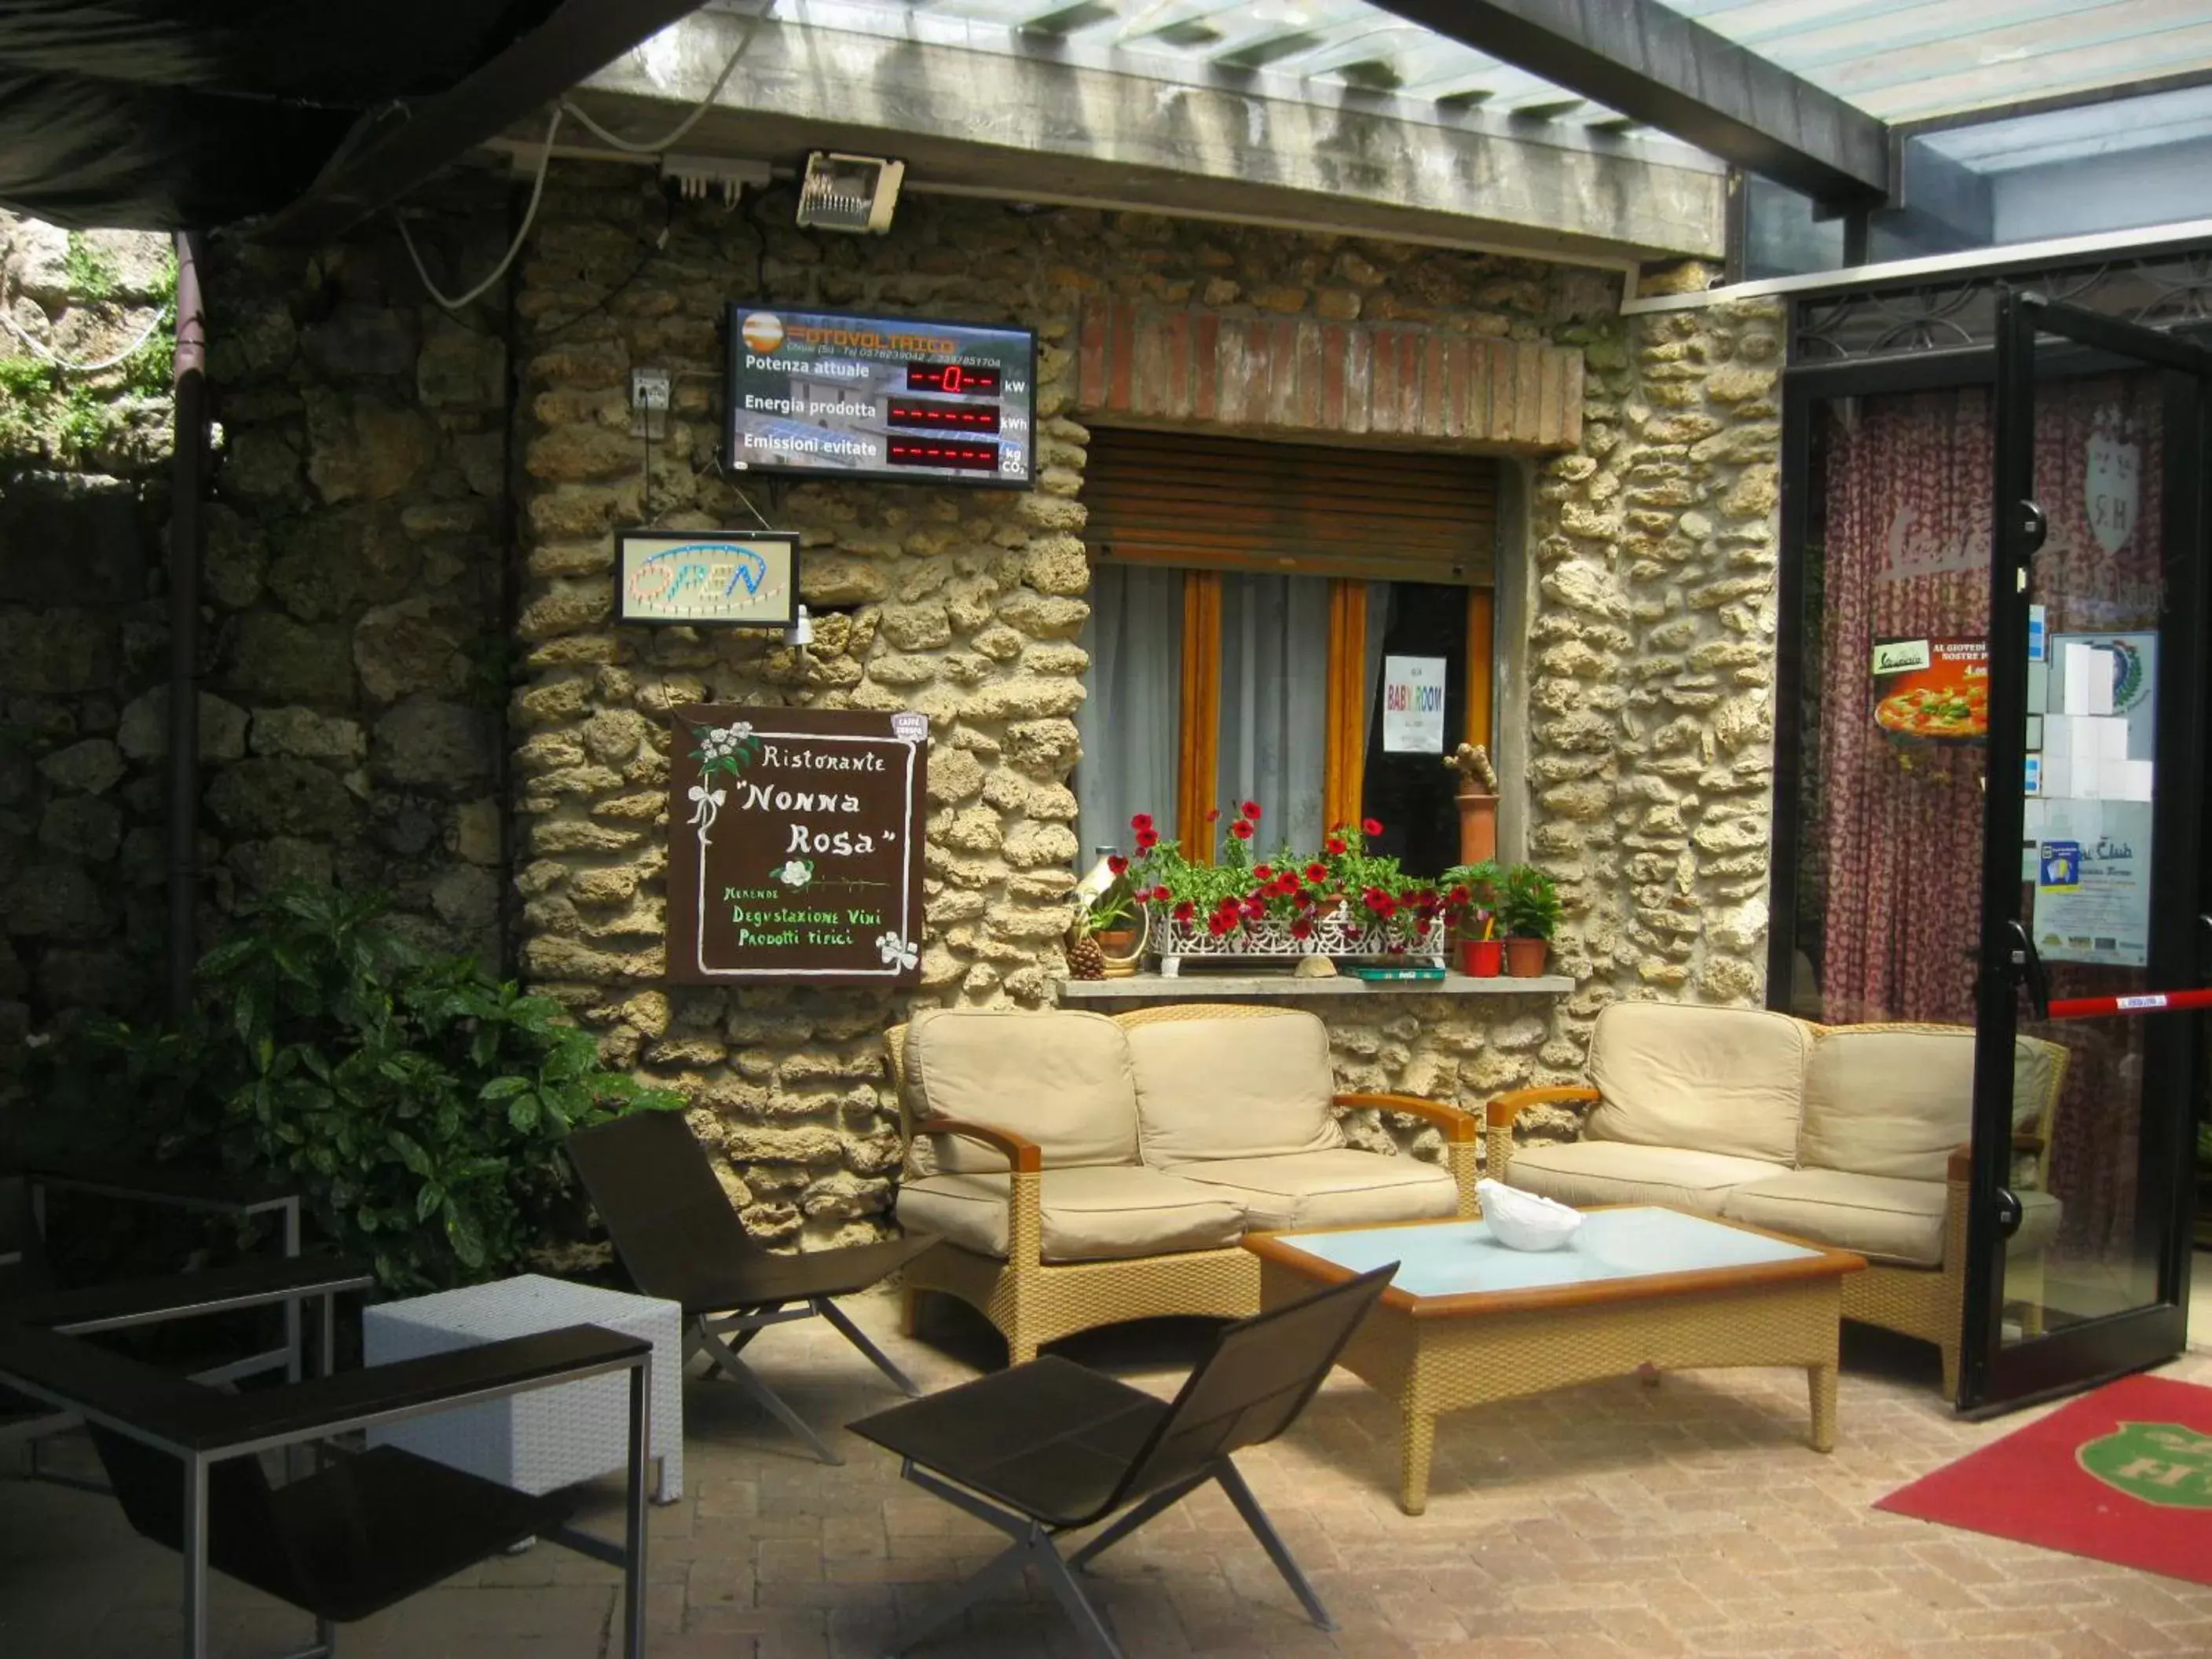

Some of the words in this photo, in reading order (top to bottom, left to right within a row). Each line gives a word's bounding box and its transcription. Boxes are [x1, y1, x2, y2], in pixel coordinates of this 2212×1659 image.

[787, 325, 955, 354] FOTOVOLTAICO
[745, 355, 810, 375] Potenza
[814, 361, 870, 377] attuale
[1005, 380, 1026, 393] kW
[745, 395, 804, 416] Energia
[810, 399, 876, 418] prodotta
[1001, 416, 1027, 430] kWh
[744, 434, 819, 452] Emissioni
[823, 437, 877, 457] evitate
[1005, 447, 1022, 461] kg
[628, 563, 767, 602] OPEN
[1415, 685, 1442, 712] ROOM
[762, 745, 886, 771] Ristorante
